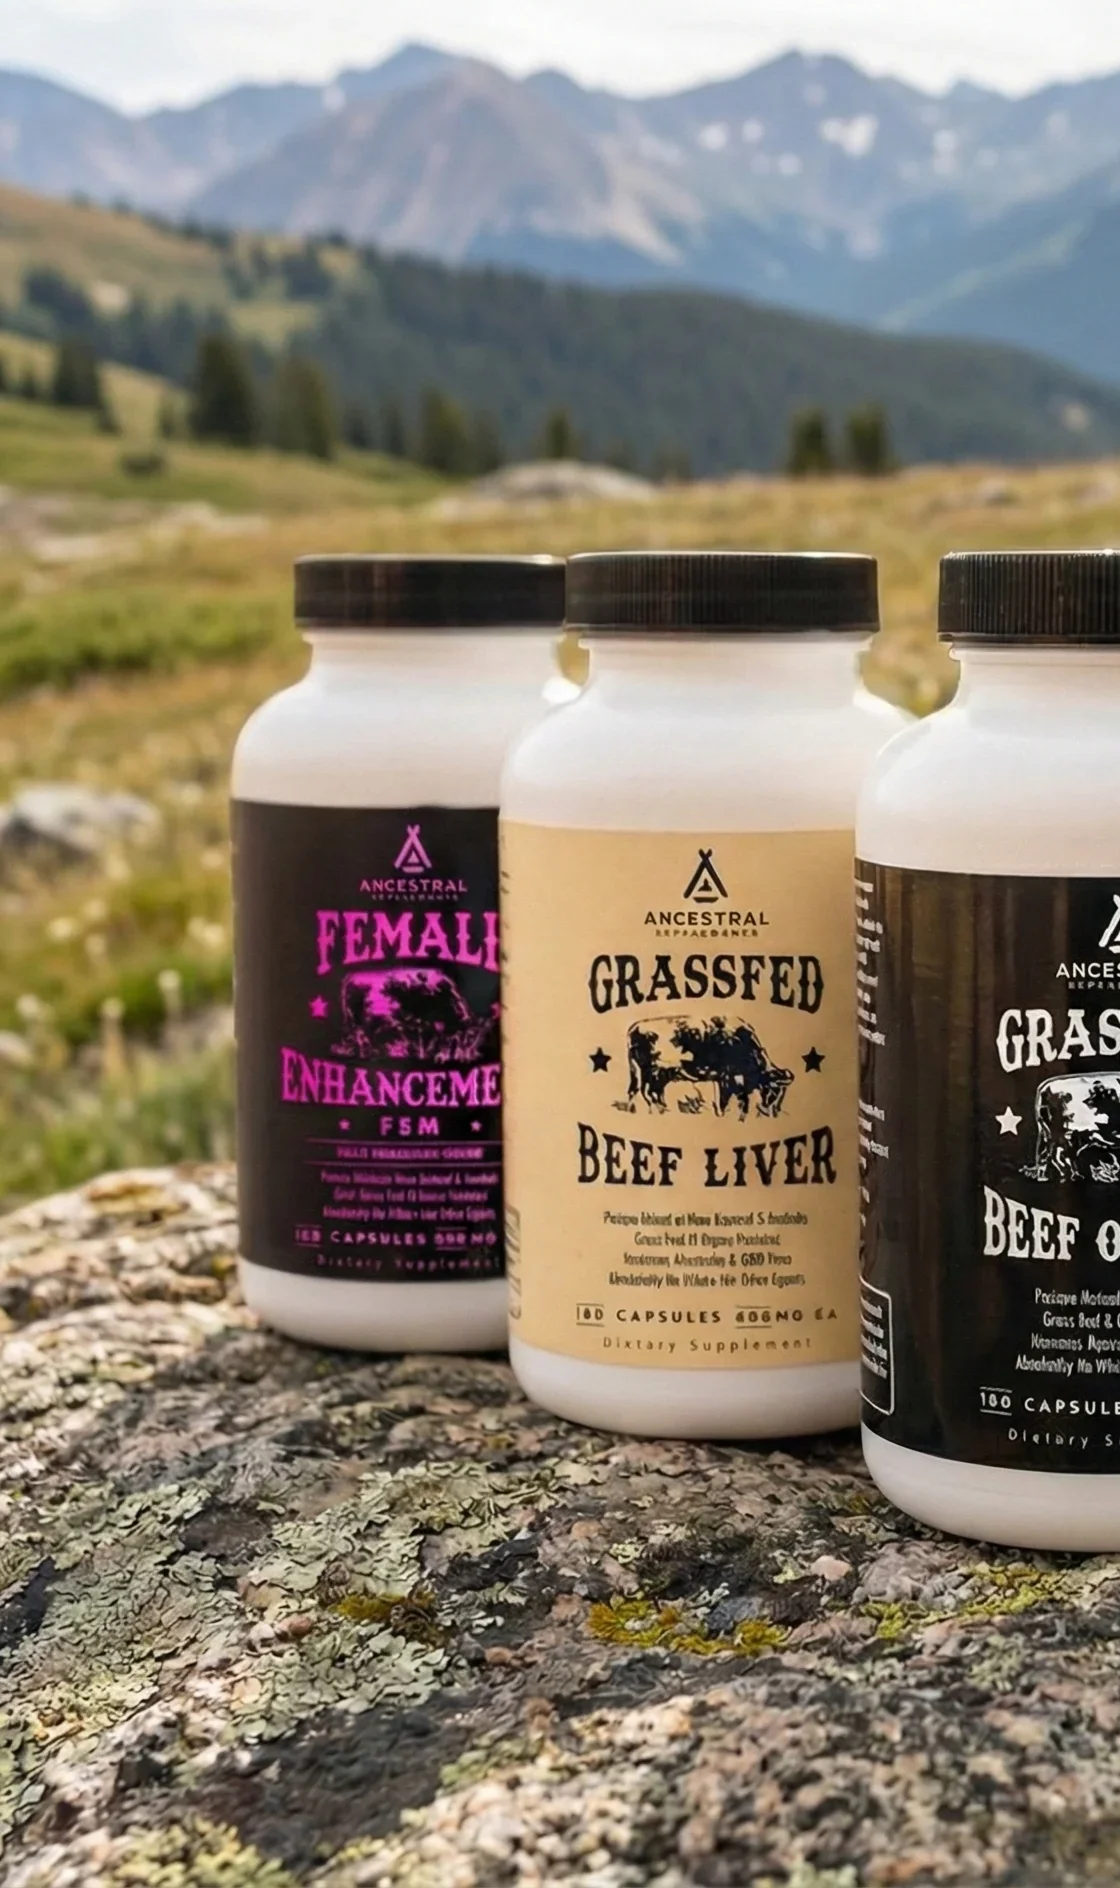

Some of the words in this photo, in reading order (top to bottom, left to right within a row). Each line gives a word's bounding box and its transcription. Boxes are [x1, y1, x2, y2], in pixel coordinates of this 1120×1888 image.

[359, 879, 468, 892] ANCESTRAL
[644, 911, 770, 926] ANCESTRAL
[588, 954, 824, 1014] GRASSFED
[380, 1116, 439, 1137] FSM
[577, 1121, 683, 1187] BEEF
[703, 1125, 837, 1188] LIVER
[983, 1185, 1080, 1261] BEEF
[330, 1231, 427, 1245] CAPSULES
[616, 1309, 720, 1324] CAPSULES
[690, 1337, 811, 1354] Supplement
